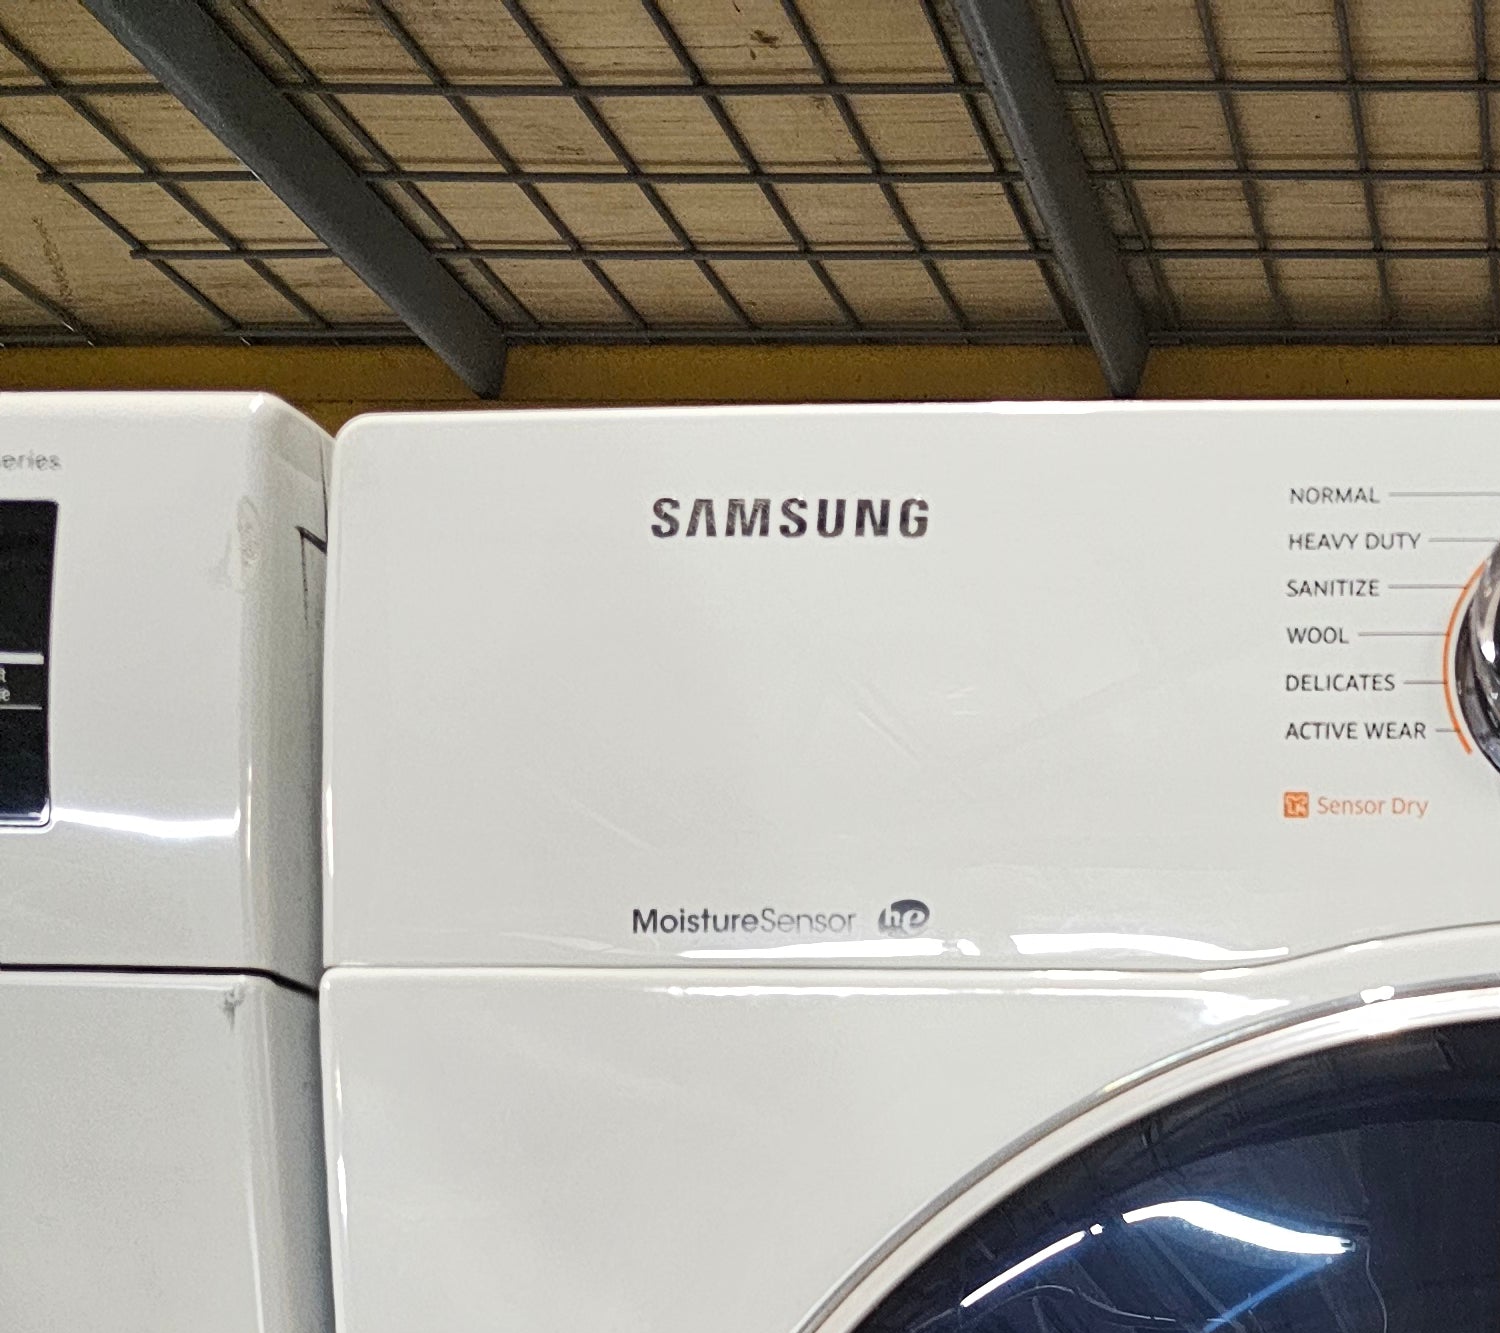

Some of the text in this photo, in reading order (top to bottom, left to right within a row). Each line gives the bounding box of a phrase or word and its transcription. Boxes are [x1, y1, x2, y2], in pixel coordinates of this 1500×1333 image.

[0, 449, 62, 471] eries
[1291, 487, 1379, 504] NORMAL
[651, 498, 928, 538] SAMSUNG
[1290, 532, 1421, 550] HEAVY DUTY
[1287, 580, 1378, 597] SANITIZE
[1287, 626, 1348, 644] WOOL
[1286, 674, 1395, 691] DELICATES
[1286, 722, 1425, 740] ACTIVE WEAR
[1318, 796, 1428, 817] Sensor Dry
[633, 908, 856, 934] MoistureSensor
